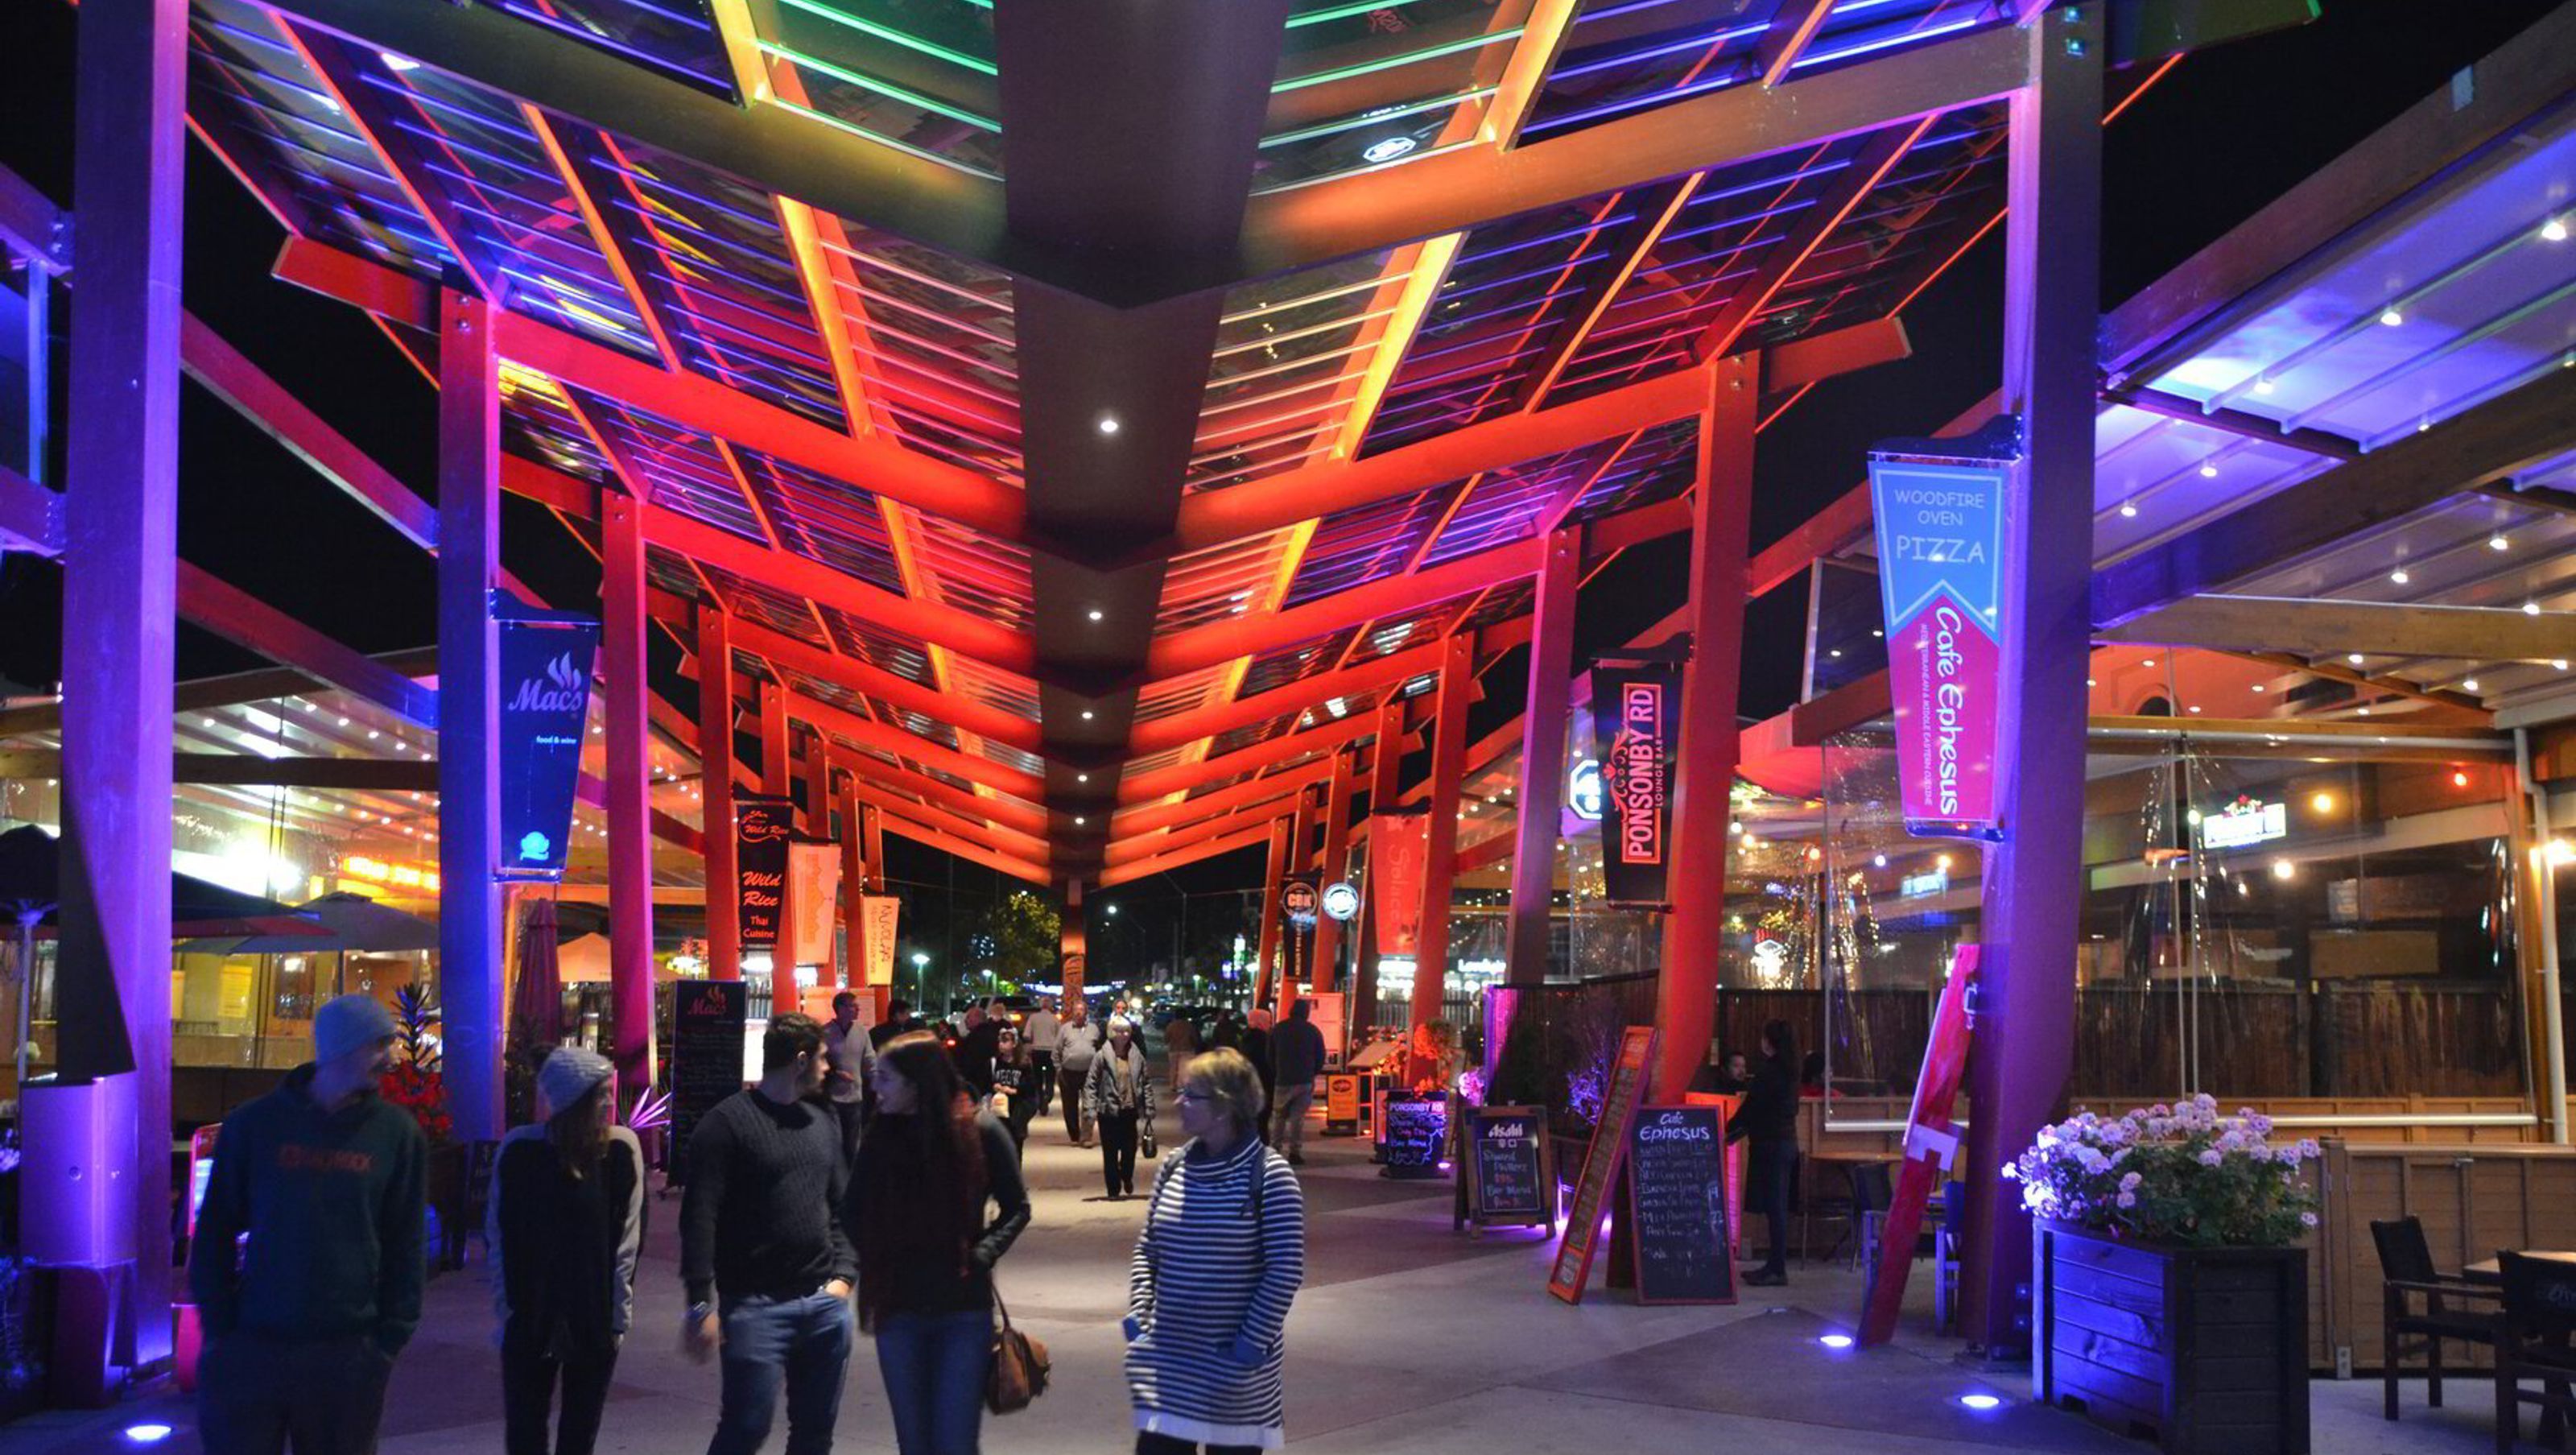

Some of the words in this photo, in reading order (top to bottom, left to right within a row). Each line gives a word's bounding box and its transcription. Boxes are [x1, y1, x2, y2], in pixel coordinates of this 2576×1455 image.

[1894, 489, 1985, 509] WOODFIRE
[1917, 510, 1964, 527] OVEN
[1896, 535, 1985, 564] PIZZA
[1935, 606, 1964, 678] Cafe
[1629, 688, 1653, 723] RD
[1654, 738, 1664, 761] BAR
[1936, 683, 1964, 815] Ephesus
[1627, 727, 1653, 858] PONSONBY
[1654, 761, 1664, 808] LOUNGE
[742, 870, 782, 887] Wild
[742, 891, 778, 907] Rice
[749, 916, 769, 926] Thai
[742, 928, 775, 939] Cuisine
[1488, 1123, 1523, 1138] Asahi
[1639, 1126, 1710, 1142] Ephesus
